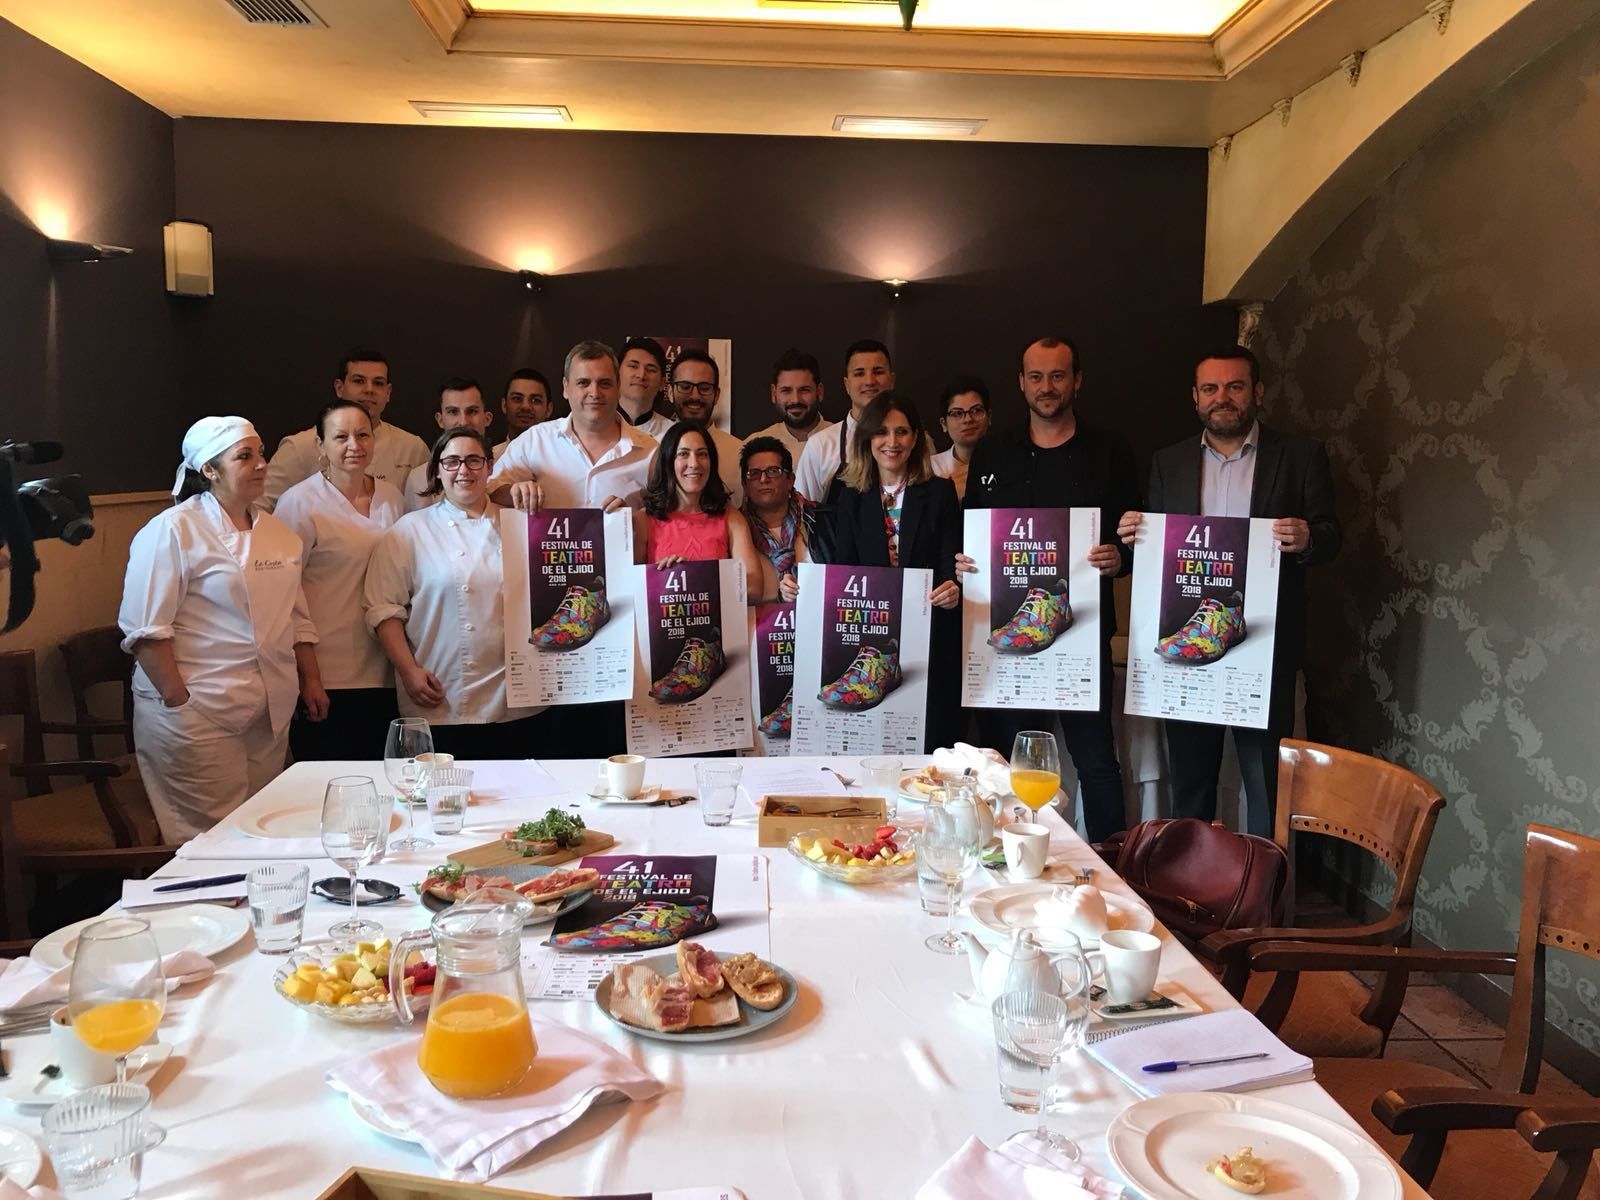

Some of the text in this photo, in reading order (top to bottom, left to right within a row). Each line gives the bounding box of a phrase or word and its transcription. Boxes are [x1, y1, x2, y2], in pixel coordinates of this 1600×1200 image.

[547, 518, 569, 538] 41
[1010, 518, 1033, 540] 41
[1185, 525, 1210, 548] 41
[541, 540, 592, 550] FESTIVAL DE
[1004, 542, 1056, 550] FESTIVAL DE
[542, 550, 593, 564] TEATRO
[1004, 552, 1056, 565] TEATRO
[1177, 549, 1234, 561] FESTIVAL DE
[542, 564, 594, 574] DE EL EJIDO
[1003, 566, 1057, 576] DE EL EJIDO
[1177, 560, 1233, 576] TEATRO
[666, 570, 686, 592] 41
[844, 575, 867, 597] 41
[1010, 576, 1028, 584] 2018
[1176, 574, 1232, 587] DE EL EJIDO
[1182, 586, 1202, 594] 2018
[660, 592, 709, 603] FESTIVAL DE
[660, 602, 710, 618] TEATRO
[837, 599, 890, 610] FESTIVAL DE
[661, 616, 710, 628] DE EL EJIDO
[837, 608, 888, 624] TEATRO
[836, 624, 888, 634] DE EL EJIDO
[768, 632, 795, 641] FESTIV
[842, 634, 860, 642] 2018
[769, 642, 795, 655] TEA
[770, 656, 792, 664] DE EL
[613, 861, 654, 874] 41
